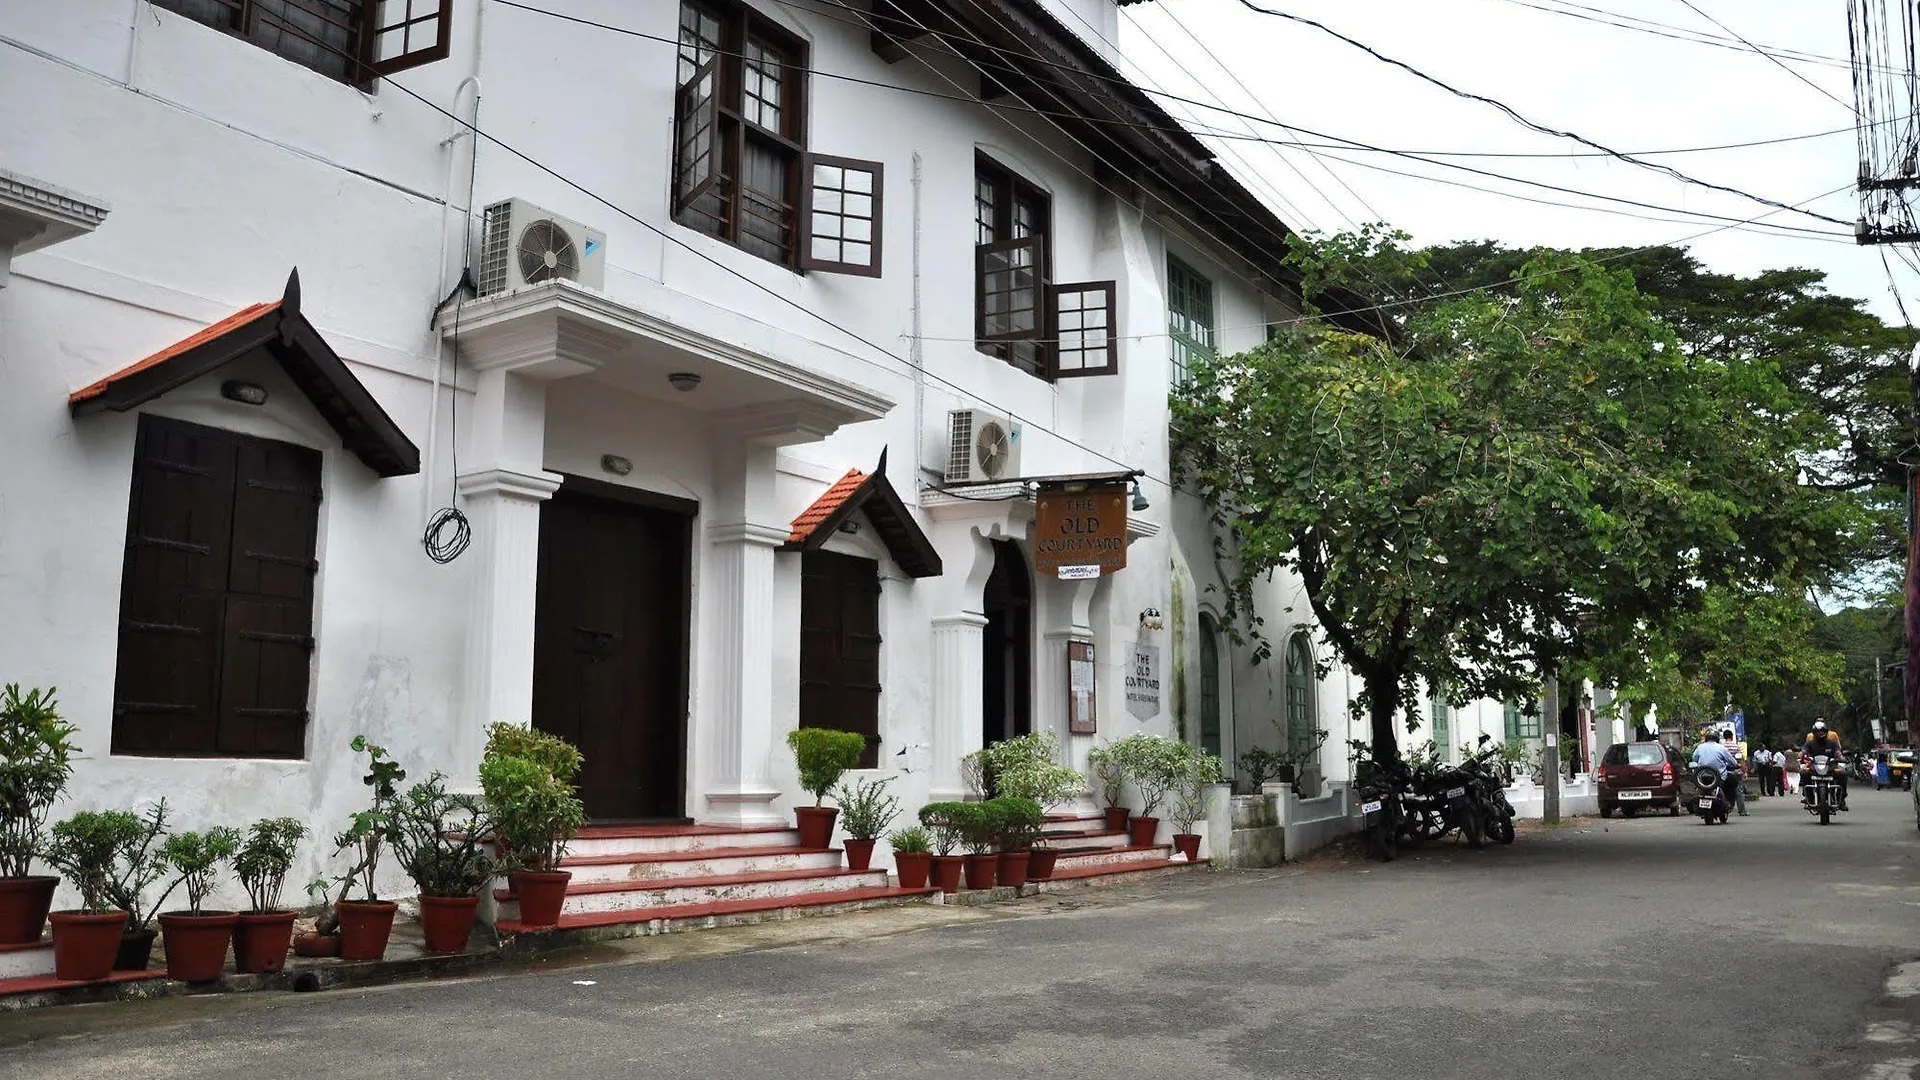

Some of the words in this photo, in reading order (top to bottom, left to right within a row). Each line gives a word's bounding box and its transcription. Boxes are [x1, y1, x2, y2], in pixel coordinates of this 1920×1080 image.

[1065, 499, 1096, 512] THE
[1061, 517, 1100, 534] OLD
[1038, 537, 1122, 554] COURTYARD
[1136, 653, 1150, 665] THE
[1136, 666, 1150, 676] OLD
[1125, 676, 1160, 690] COURTYARD
